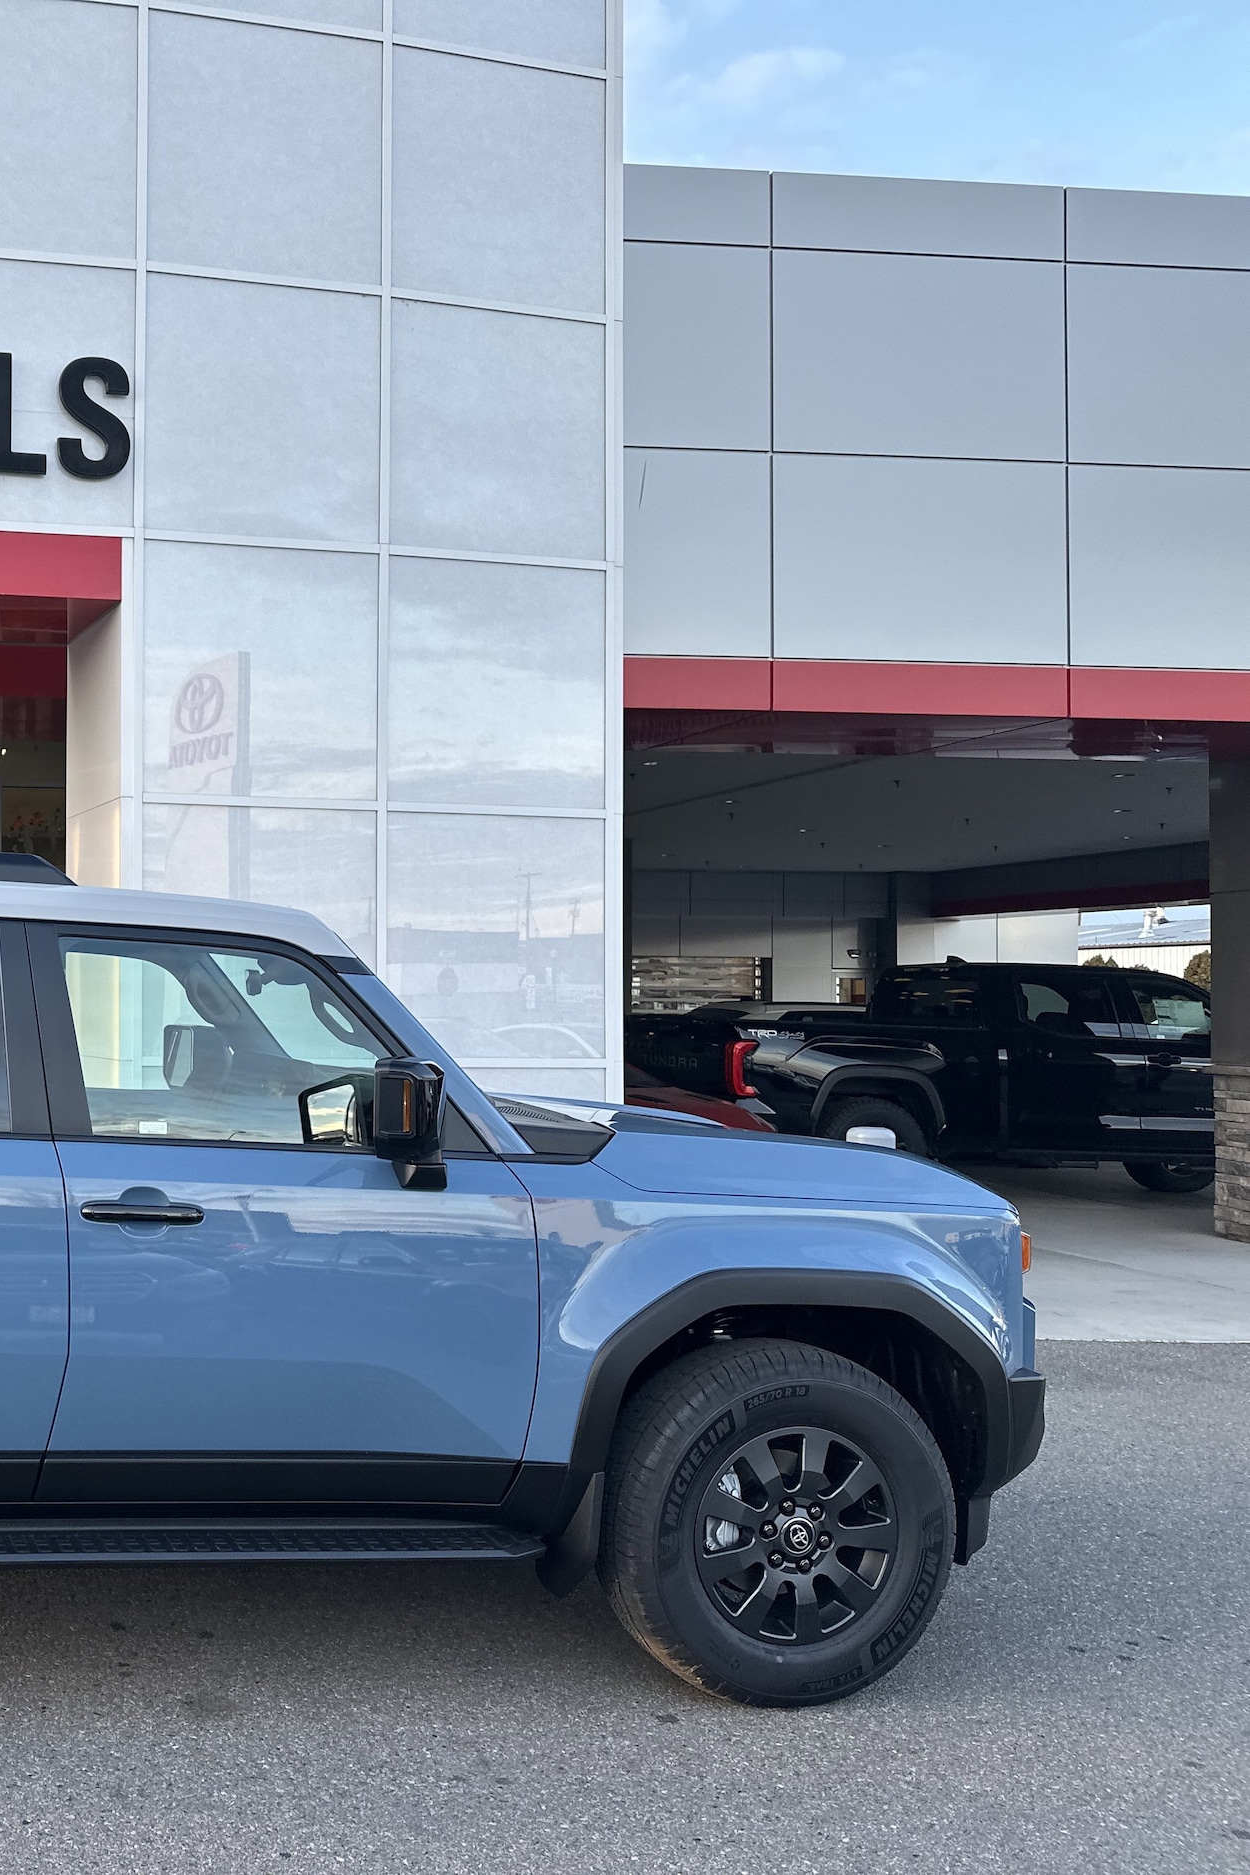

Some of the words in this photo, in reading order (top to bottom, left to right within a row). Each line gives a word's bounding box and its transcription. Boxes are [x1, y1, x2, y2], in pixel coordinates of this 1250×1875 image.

[747, 1028, 778, 1039] TRD
[642, 1053, 699, 1069] TUNDRA
[747, 1389, 781, 1409] 265/70
[785, 1387, 793, 1397] R
[795, 1386, 806, 1396] 18
[663, 1416, 732, 1528] MICHELIN
[874, 1551, 941, 1661] MICHELIN
